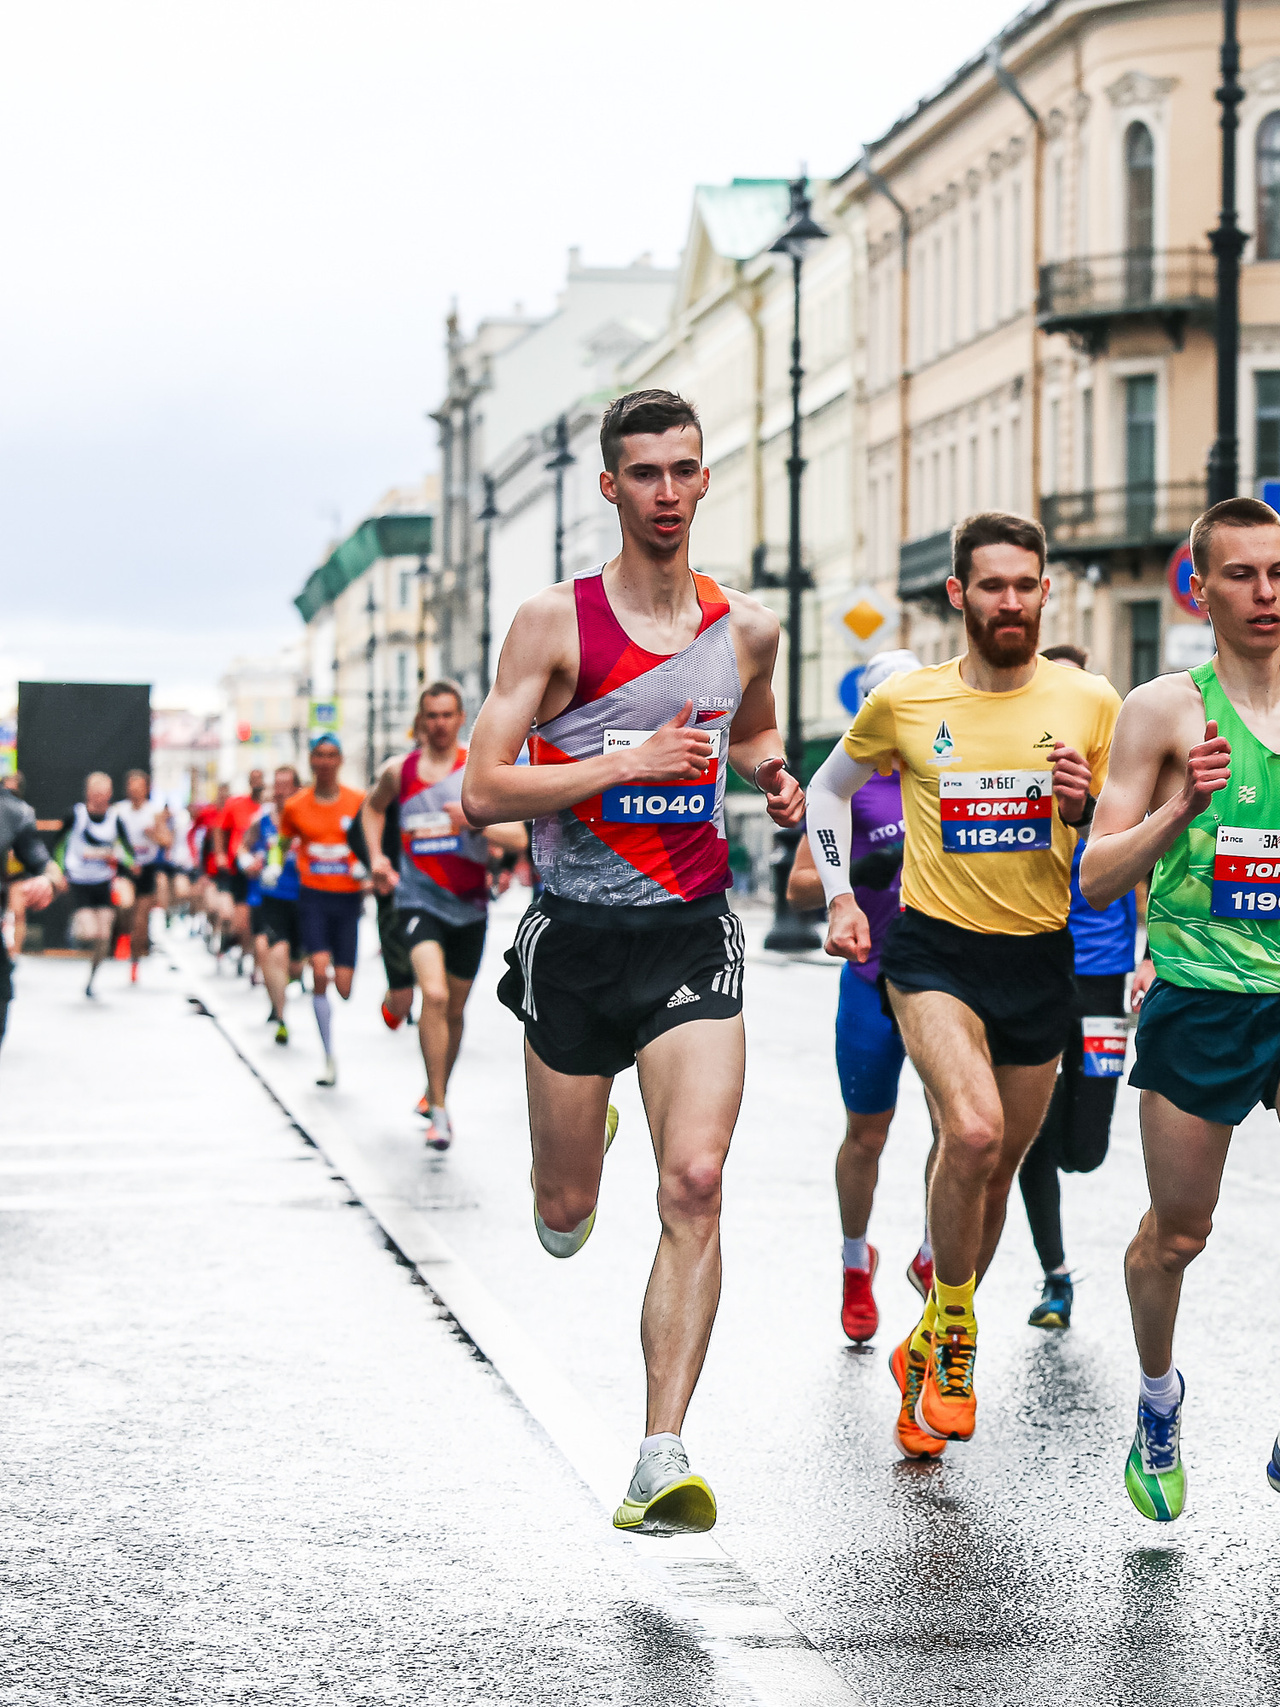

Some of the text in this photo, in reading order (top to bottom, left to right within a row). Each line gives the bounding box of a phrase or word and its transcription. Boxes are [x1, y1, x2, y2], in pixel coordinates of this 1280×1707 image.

[619, 795, 705, 815] 11040
[956, 827, 1036, 846] 11840
[666, 994, 701, 1008] adidas
